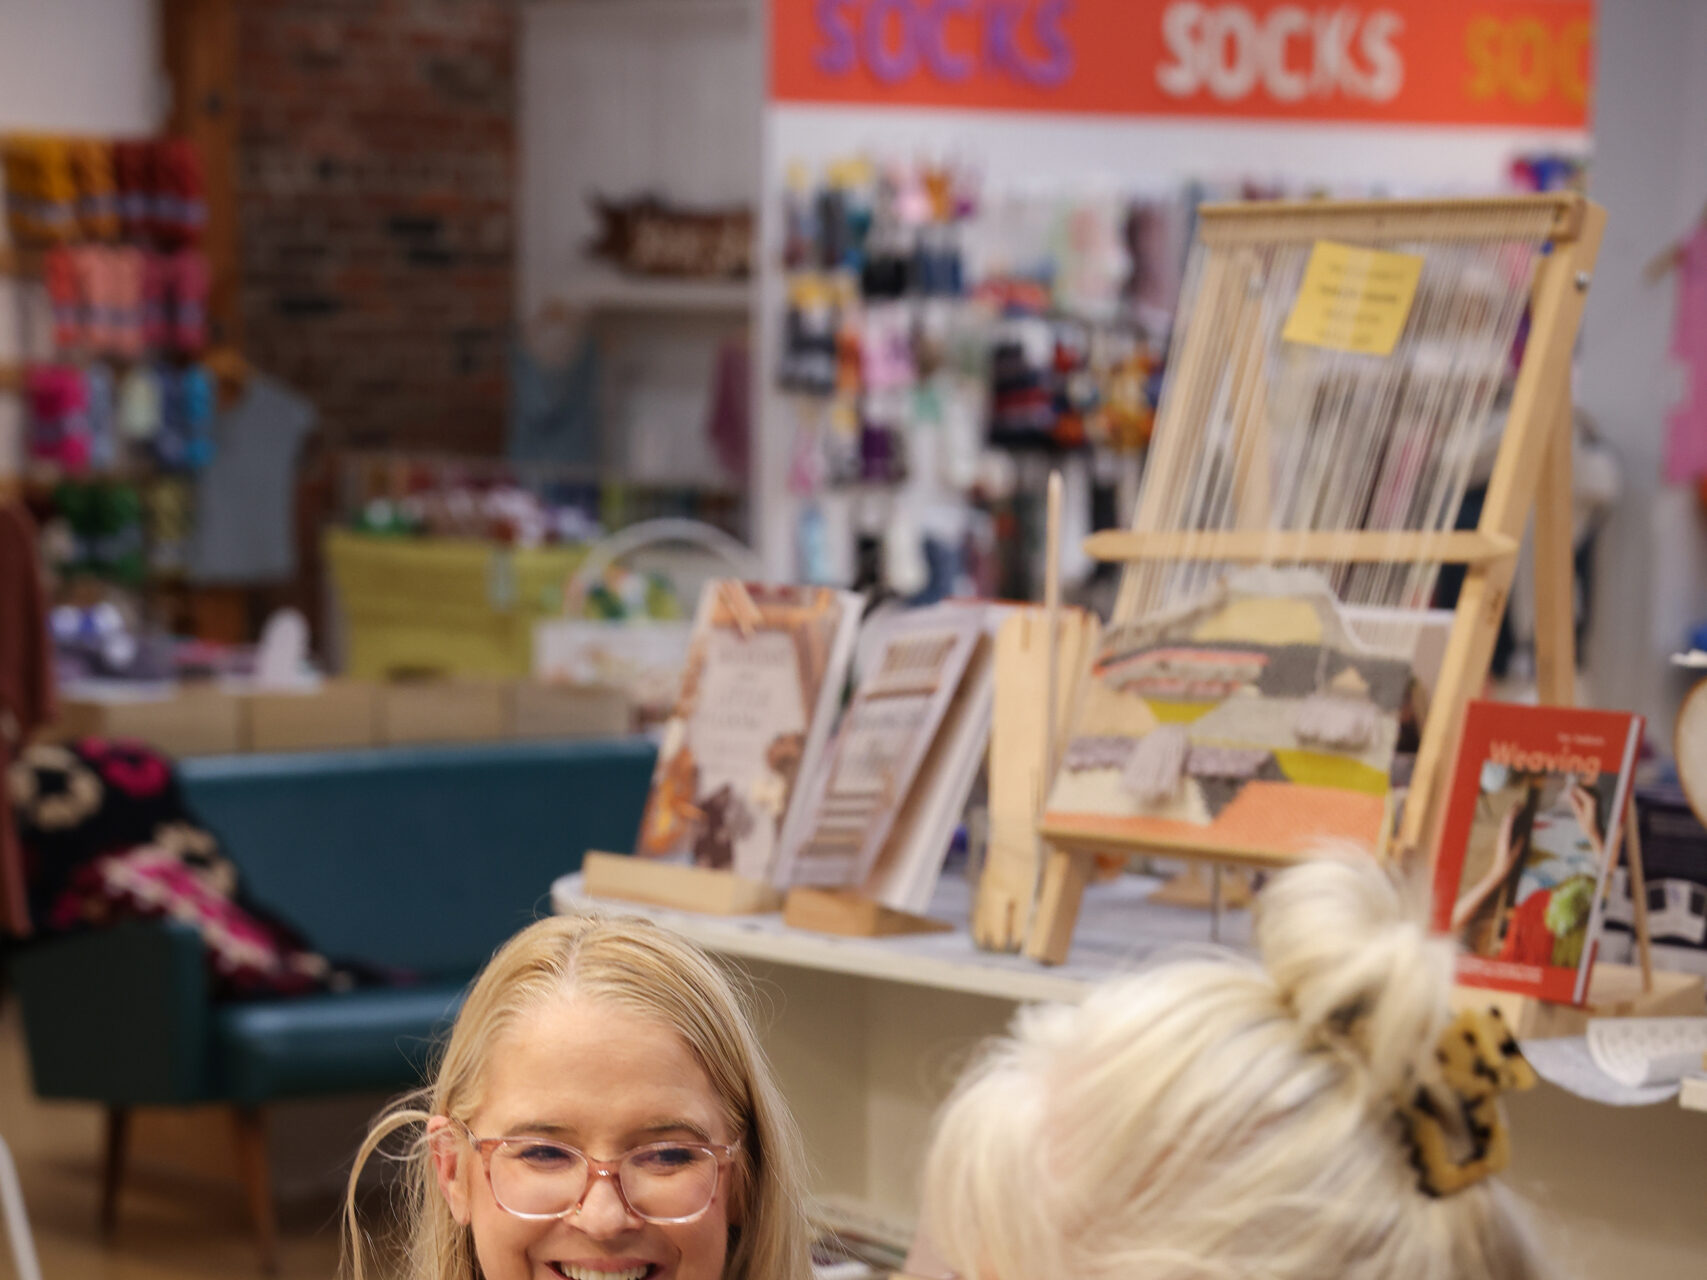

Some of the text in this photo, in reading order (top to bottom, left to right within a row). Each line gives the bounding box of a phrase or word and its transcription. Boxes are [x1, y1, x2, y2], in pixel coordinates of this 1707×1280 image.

[813, 0, 1075, 85] SOCKS
[1156, 0, 1405, 101] SOCKS
[1489, 739, 1601, 786] Weaving
